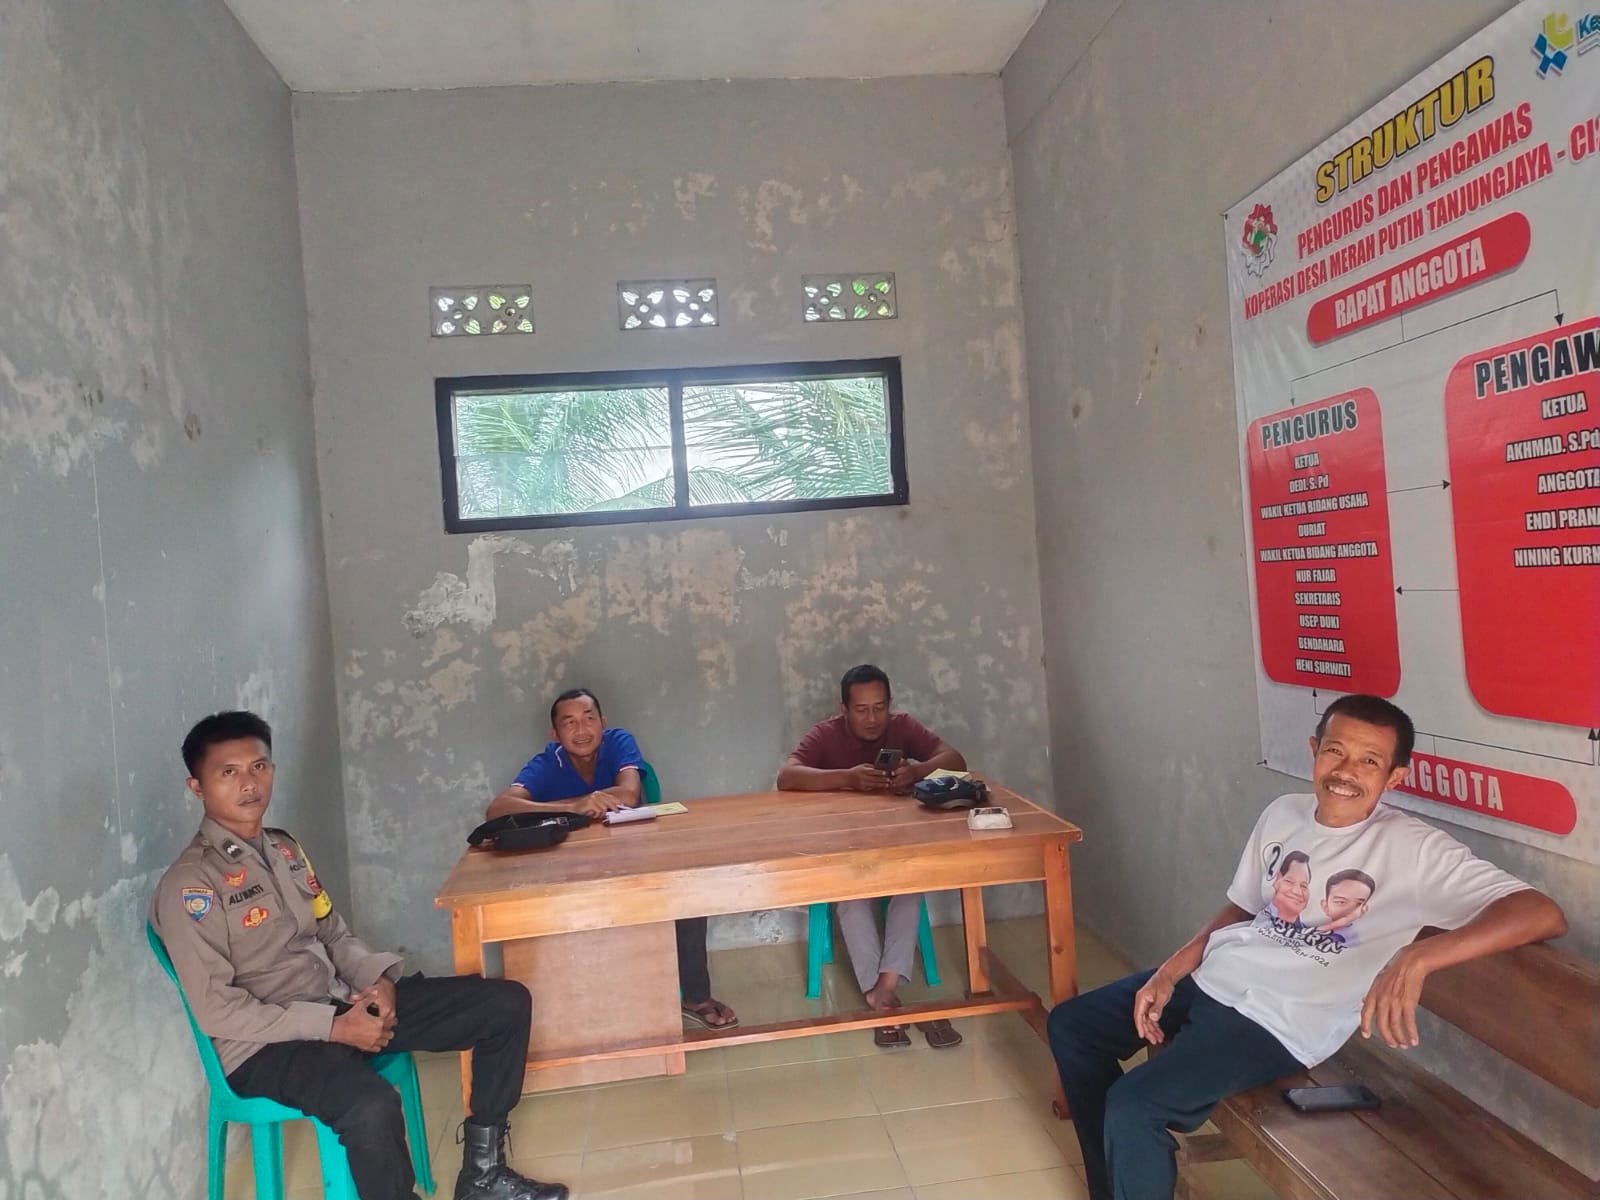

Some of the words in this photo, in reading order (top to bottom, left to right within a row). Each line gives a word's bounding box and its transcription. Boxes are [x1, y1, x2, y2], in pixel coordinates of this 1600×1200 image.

[1315, 55, 1495, 204] STRUKTUR
[1297, 195, 1374, 260] PENGURUS
[1377, 171, 1413, 218] DAN
[1416, 102, 1533, 195] PENGAWAS
[1244, 279, 1295, 321] KOPERASI
[1296, 263, 1328, 295] DESA
[1329, 235, 1376, 281] MERAH
[1378, 209, 1424, 257] PUTIH
[1426, 143, 1553, 234] TANJUNGJAYA
[1334, 280, 1386, 329] RAPAT
[1389, 237, 1487, 307] ANGGOTA
[1542, 392, 1587, 419] KETUA
[1261, 400, 1358, 450] PENGURUS
[1294, 453, 1320, 470] KETUA
[1506, 435, 1567, 462] AKHMAD.
[1260, 504, 1282, 520] WAKIL
[1283, 502, 1306, 517] KETUA
[1307, 497, 1338, 514] BIDANG
[1339, 493, 1369, 510] USAHA
[1526, 511, 1557, 531] ENDI
[1260, 548, 1282, 562] WAKIL
[1282, 547, 1306, 561] KETUA
[1306, 544, 1336, 560] BIDANG
[1337, 542, 1378, 558] ANGGOTA
[1514, 547, 1561, 567] NINING
[1295, 569, 1312, 583] NUR
[1312, 568, 1336, 583] FAJAR
[1294, 592, 1341, 606] SEKRETARIS
[1299, 615, 1319, 628] USEP
[1297, 637, 1345, 653] BENDAHARA
[1402, 757, 1504, 812] NGGOTA
